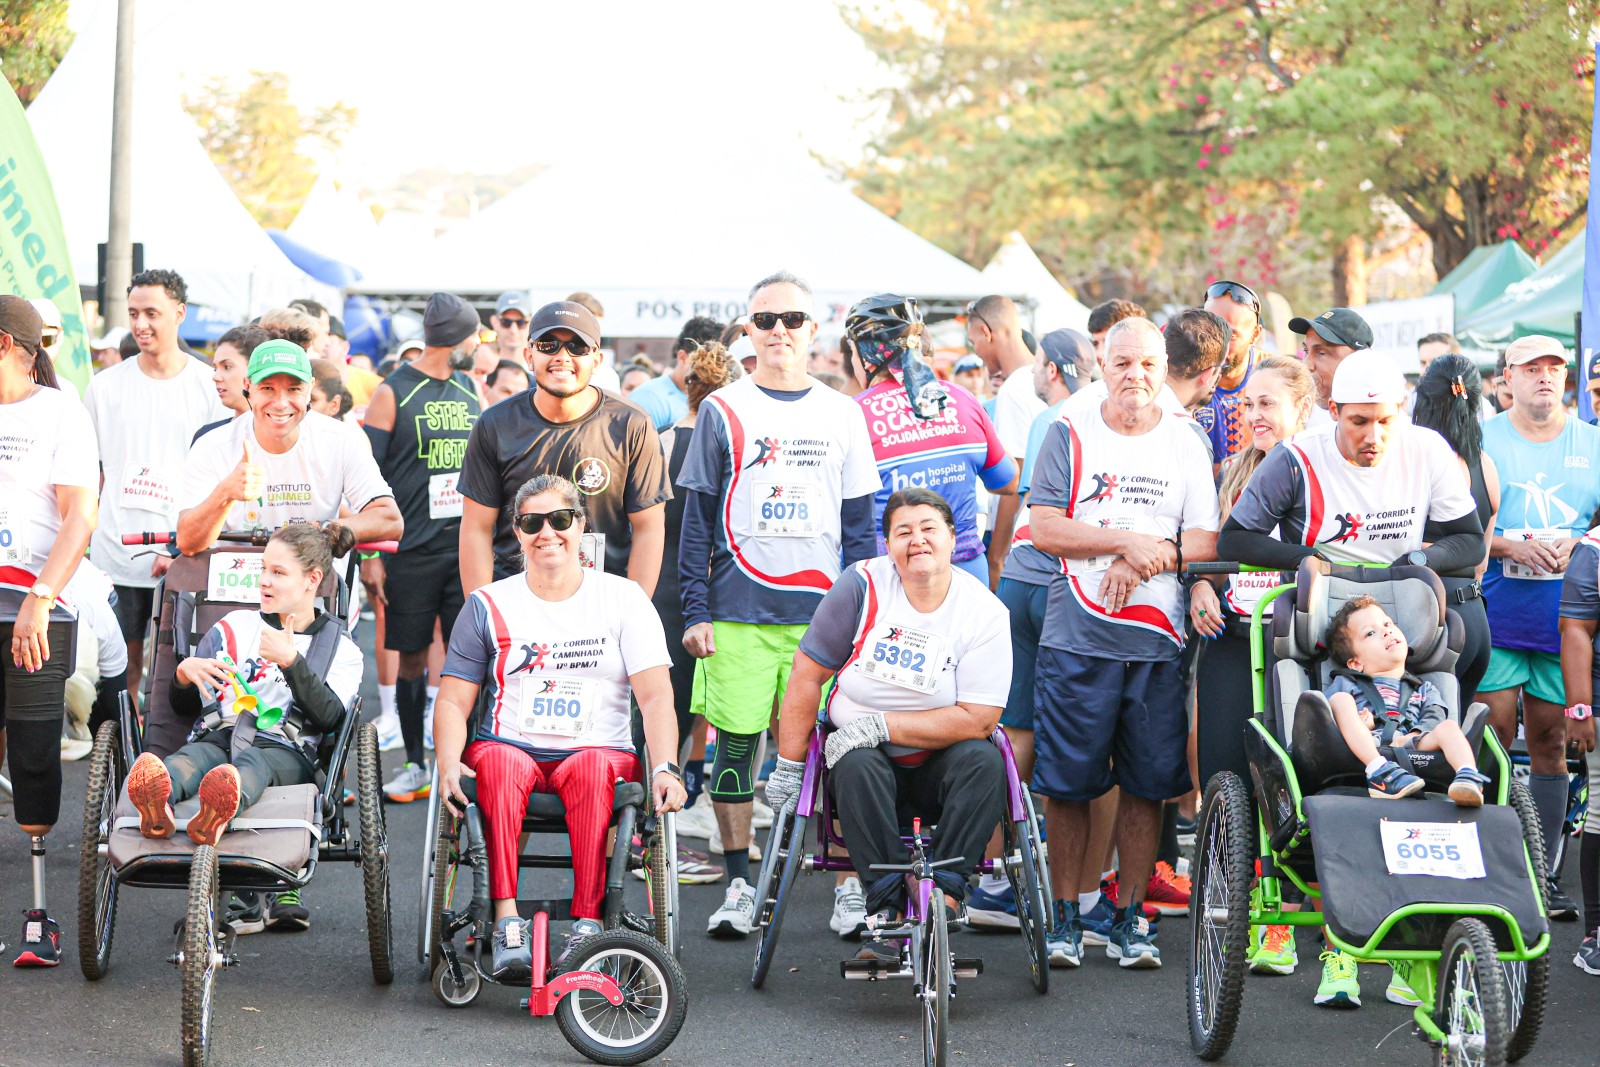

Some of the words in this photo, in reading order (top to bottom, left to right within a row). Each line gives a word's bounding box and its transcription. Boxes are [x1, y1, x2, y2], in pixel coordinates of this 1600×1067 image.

[424, 401, 473, 431] STRE
[873, 420, 887, 436] O
[792, 439, 824, 447] CORRIDA
[927, 462, 965, 477] hospital
[132, 478, 168, 492] PERNAS
[930, 477, 941, 486] de
[943, 474, 966, 484] amor
[1130, 475, 1163, 487] CORRIDA
[267, 484, 312, 492] INSTITUTO
[1119, 486, 1164, 498] CAMINHADA
[124, 487, 174, 503] SOLIDÁRIAS
[267, 492, 312, 502] UNIMED
[761, 502, 809, 520] 6078
[1376, 508, 1409, 519] CORRIDA
[1411, 506, 1416, 514] E
[1366, 518, 1413, 531] CAMINHADA
[0, 529, 12, 547] 0
[563, 638, 599, 648] CORRIDA
[601, 637, 606, 645] E
[552, 649, 604, 659] CAMINHADA
[873, 642, 926, 672] 5392
[533, 698, 581, 718] 5160
[1397, 843, 1461, 861] 6055
[565, 974, 604, 984] FreeWheel
